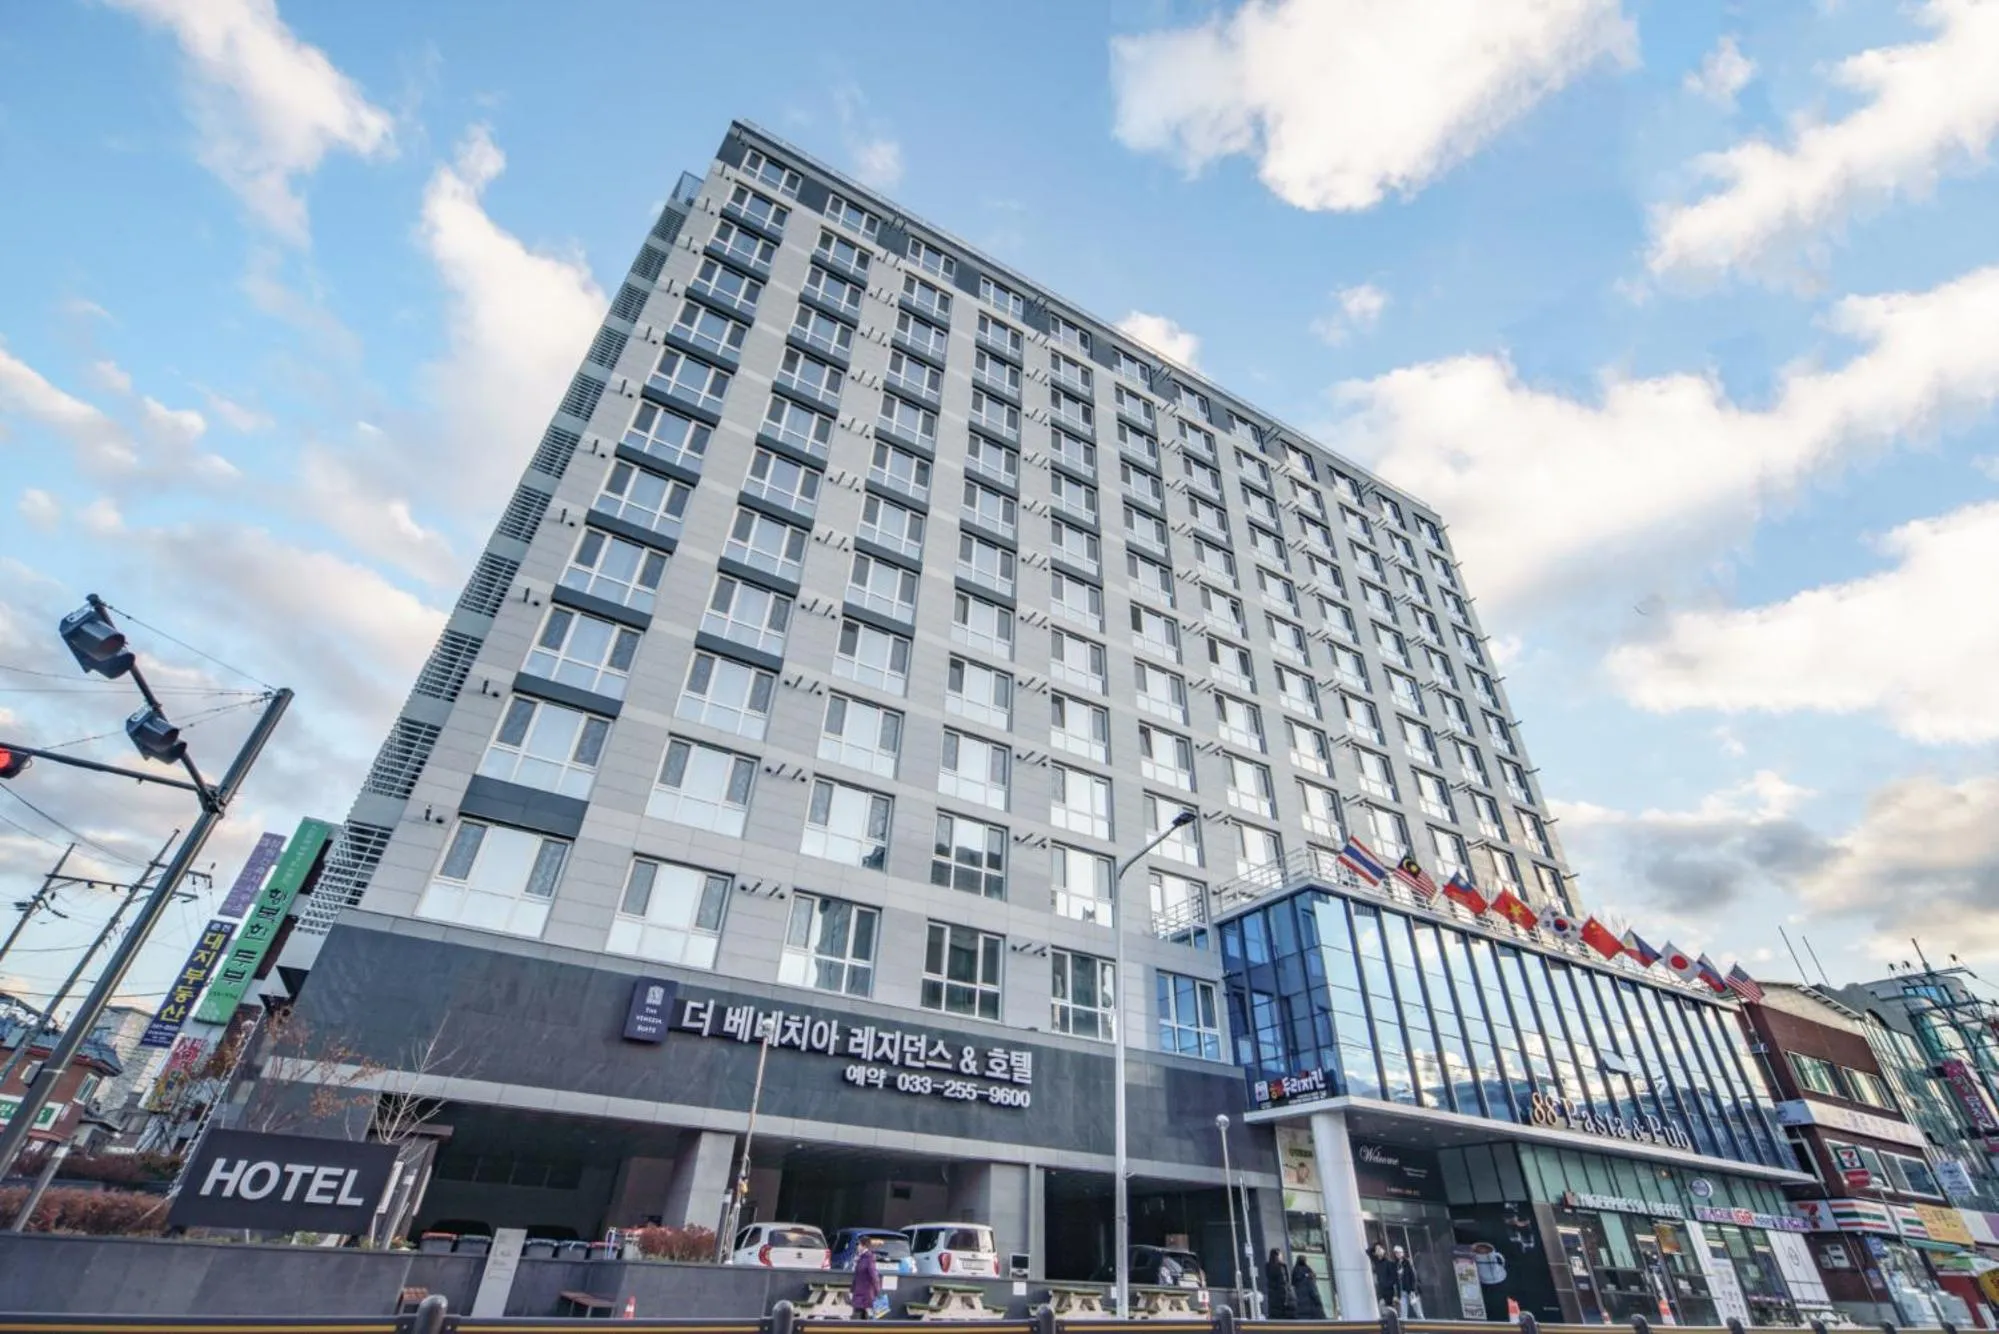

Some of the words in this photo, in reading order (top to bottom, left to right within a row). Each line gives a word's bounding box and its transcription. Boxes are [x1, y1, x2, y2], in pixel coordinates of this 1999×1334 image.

[160, 931, 226, 1023] 대지부동산
[682, 998, 715, 1037] 더
[723, 1005, 840, 1056] 베네치아
[848, 1026, 953, 1069] 레지던스
[959, 1046, 978, 1075] &
[985, 1047, 1033, 1085] 호텔
[845, 1065, 888, 1090] 예약
[897, 1072, 1031, 1109] 033-255-9600
[1532, 1091, 1558, 1126] 88
[1560, 1097, 1627, 1140] Pasta
[1632, 1116, 1645, 1142] &
[1645, 1113, 1690, 1150] Pub
[200, 1157, 364, 1206] HOTEL
